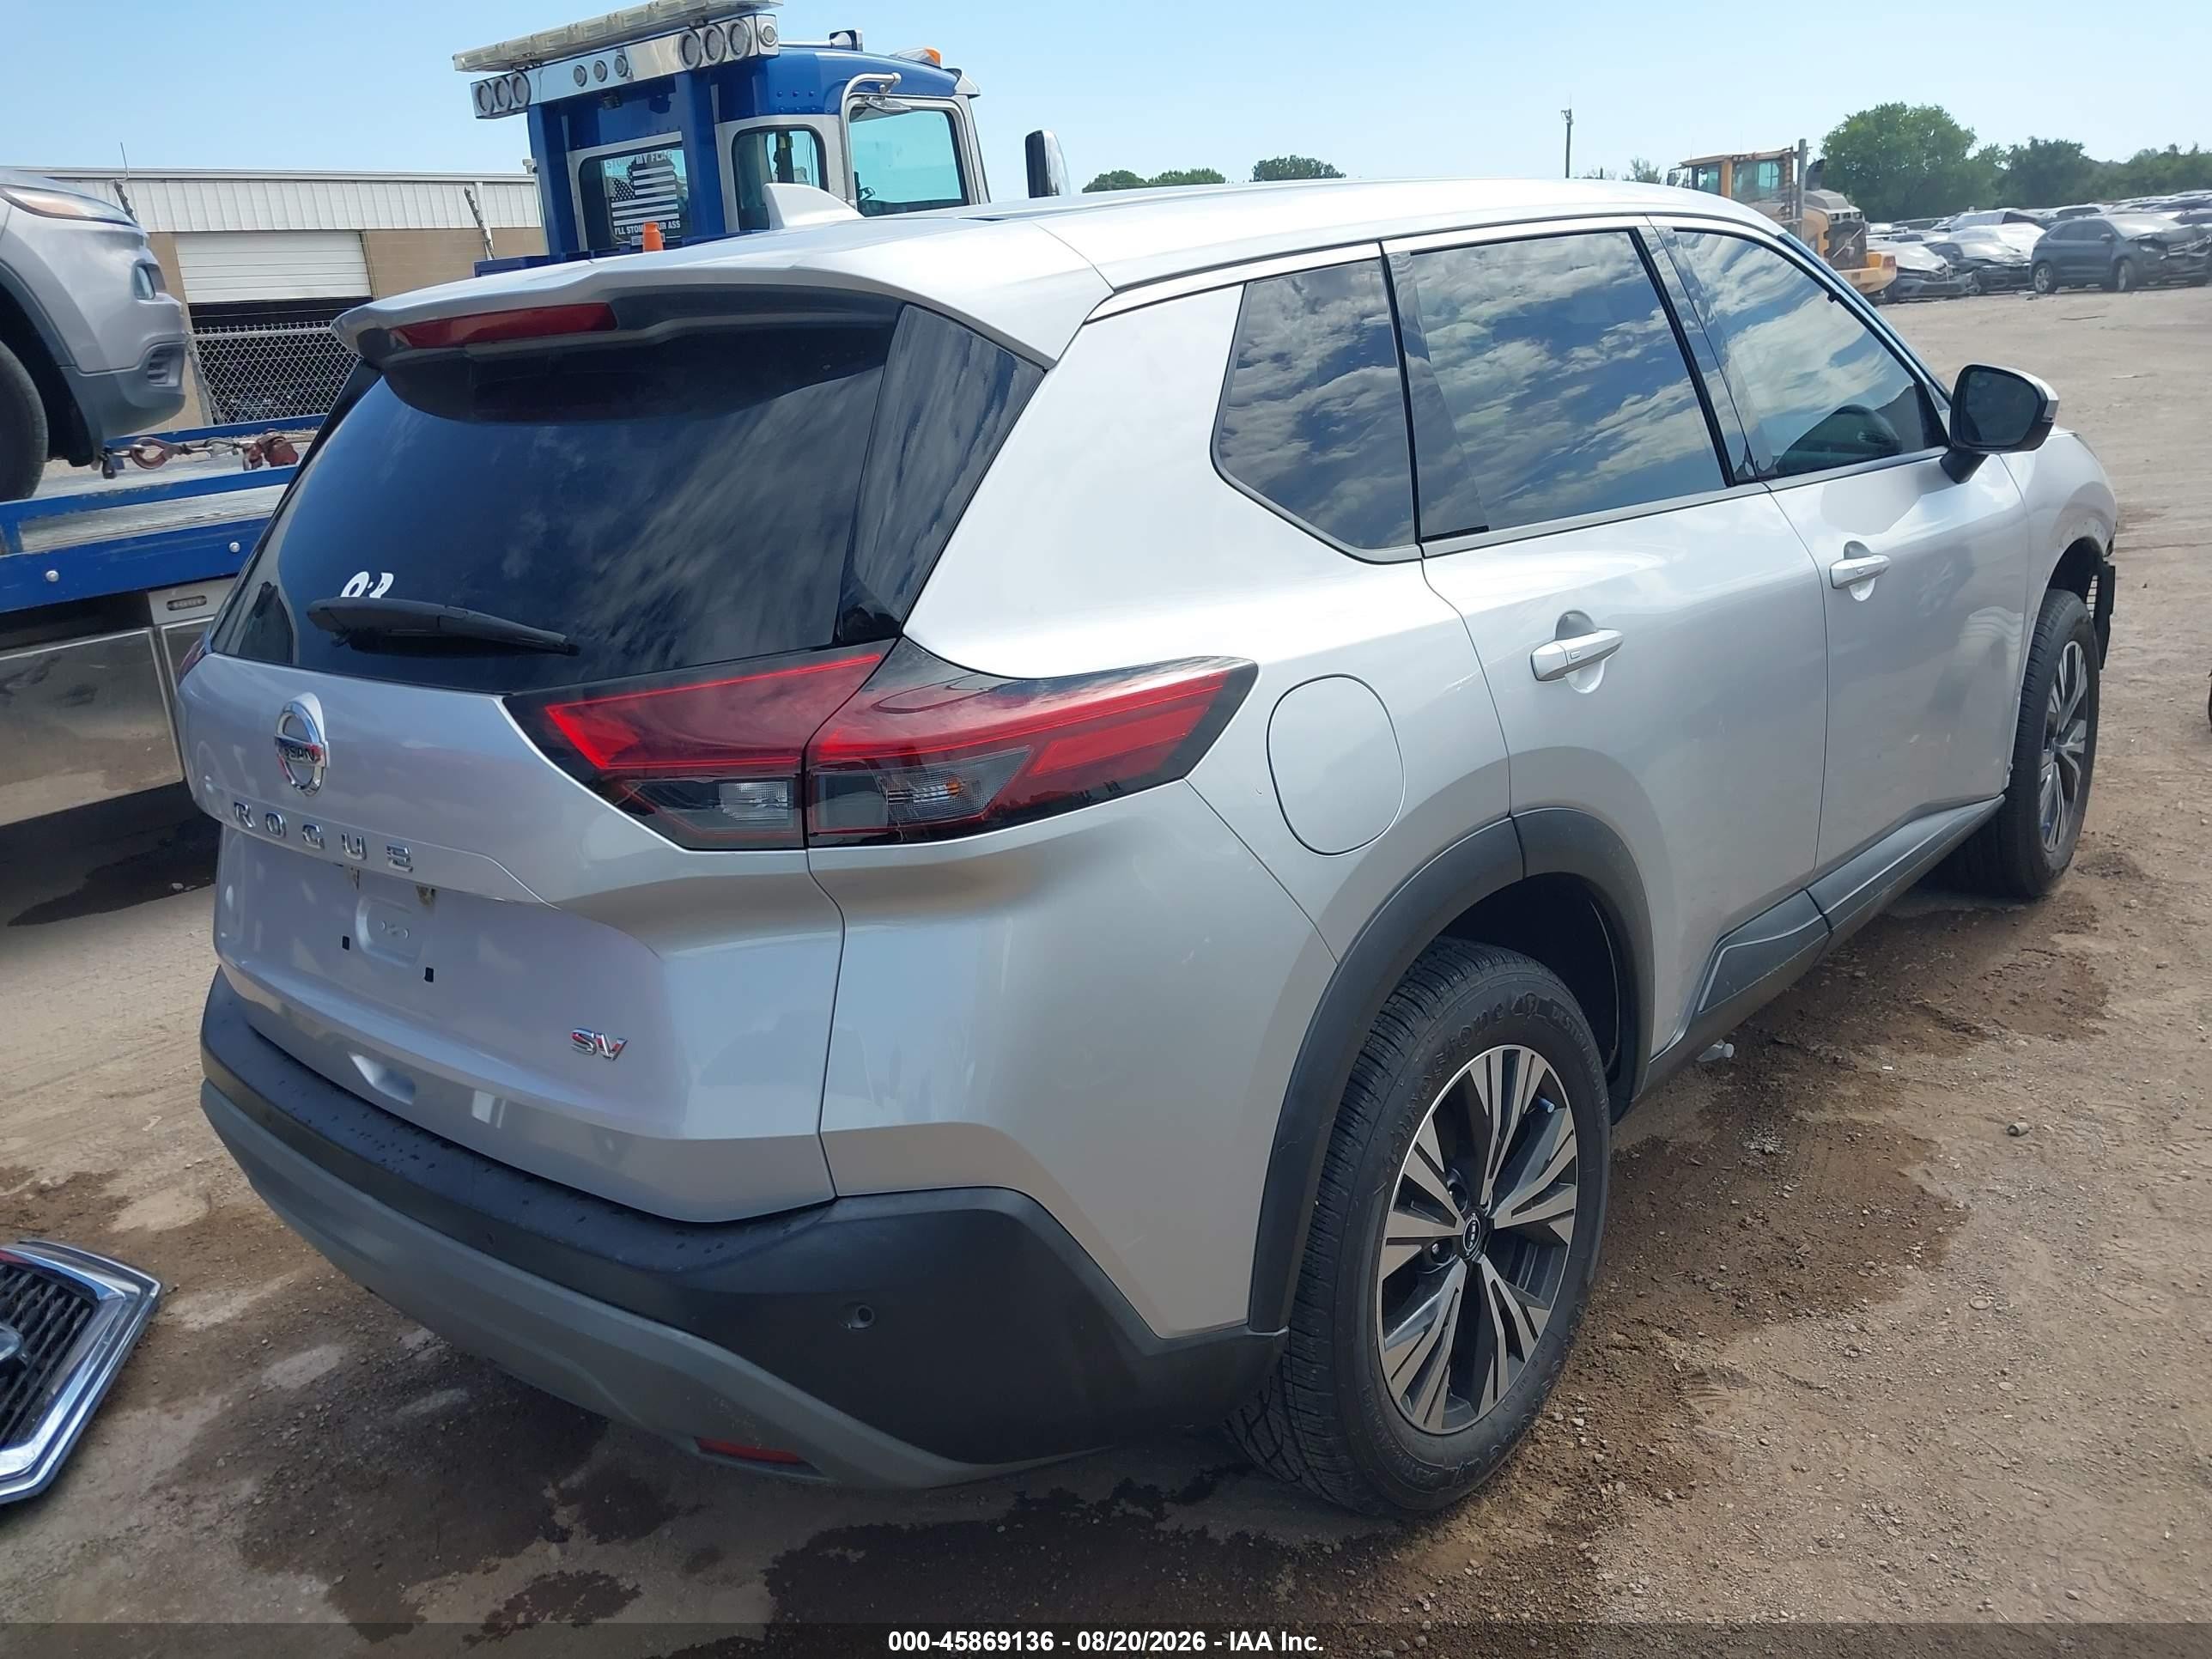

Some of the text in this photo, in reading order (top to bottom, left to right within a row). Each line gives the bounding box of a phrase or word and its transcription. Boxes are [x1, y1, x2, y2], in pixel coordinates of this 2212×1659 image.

[635, 153, 648, 165] MY
[650, 149, 673, 162] FLAG
[626, 224, 644, 234] STOM
[667, 220, 681, 229] ASS
[233, 800, 414, 873] ROGUE
[570, 1027, 629, 1061] SV
